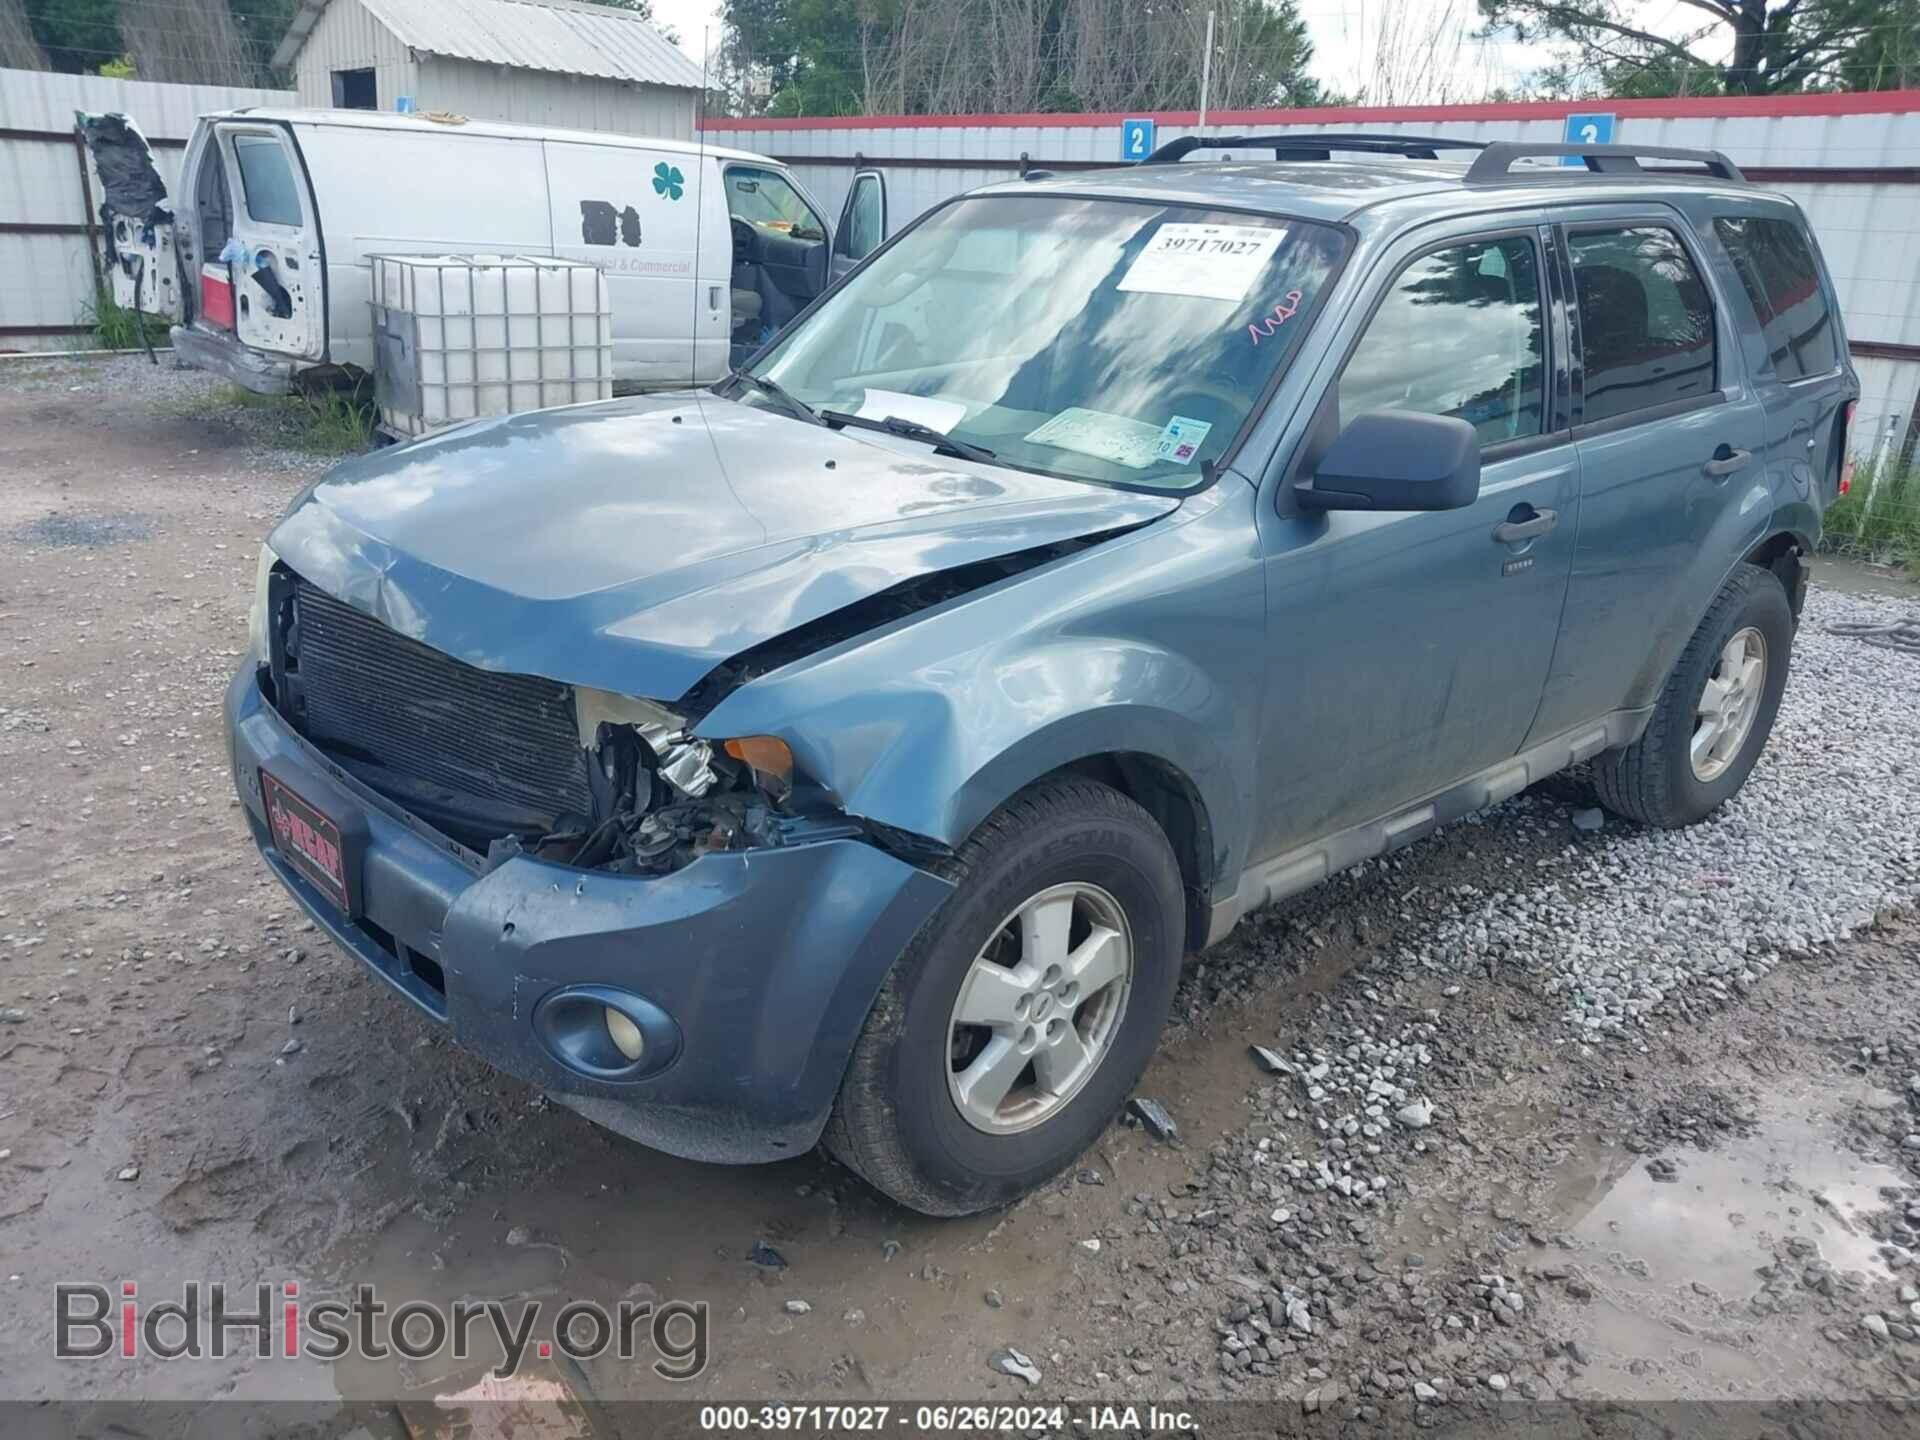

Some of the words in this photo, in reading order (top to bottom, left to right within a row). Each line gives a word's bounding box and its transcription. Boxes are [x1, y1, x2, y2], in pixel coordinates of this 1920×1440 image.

[1132, 127, 1144, 153] 2
[1157, 236, 1262, 255] 39717027
[619, 258, 629, 271] &
[630, 257, 691, 274] Commercial
[1175, 443, 1195, 459] 25
